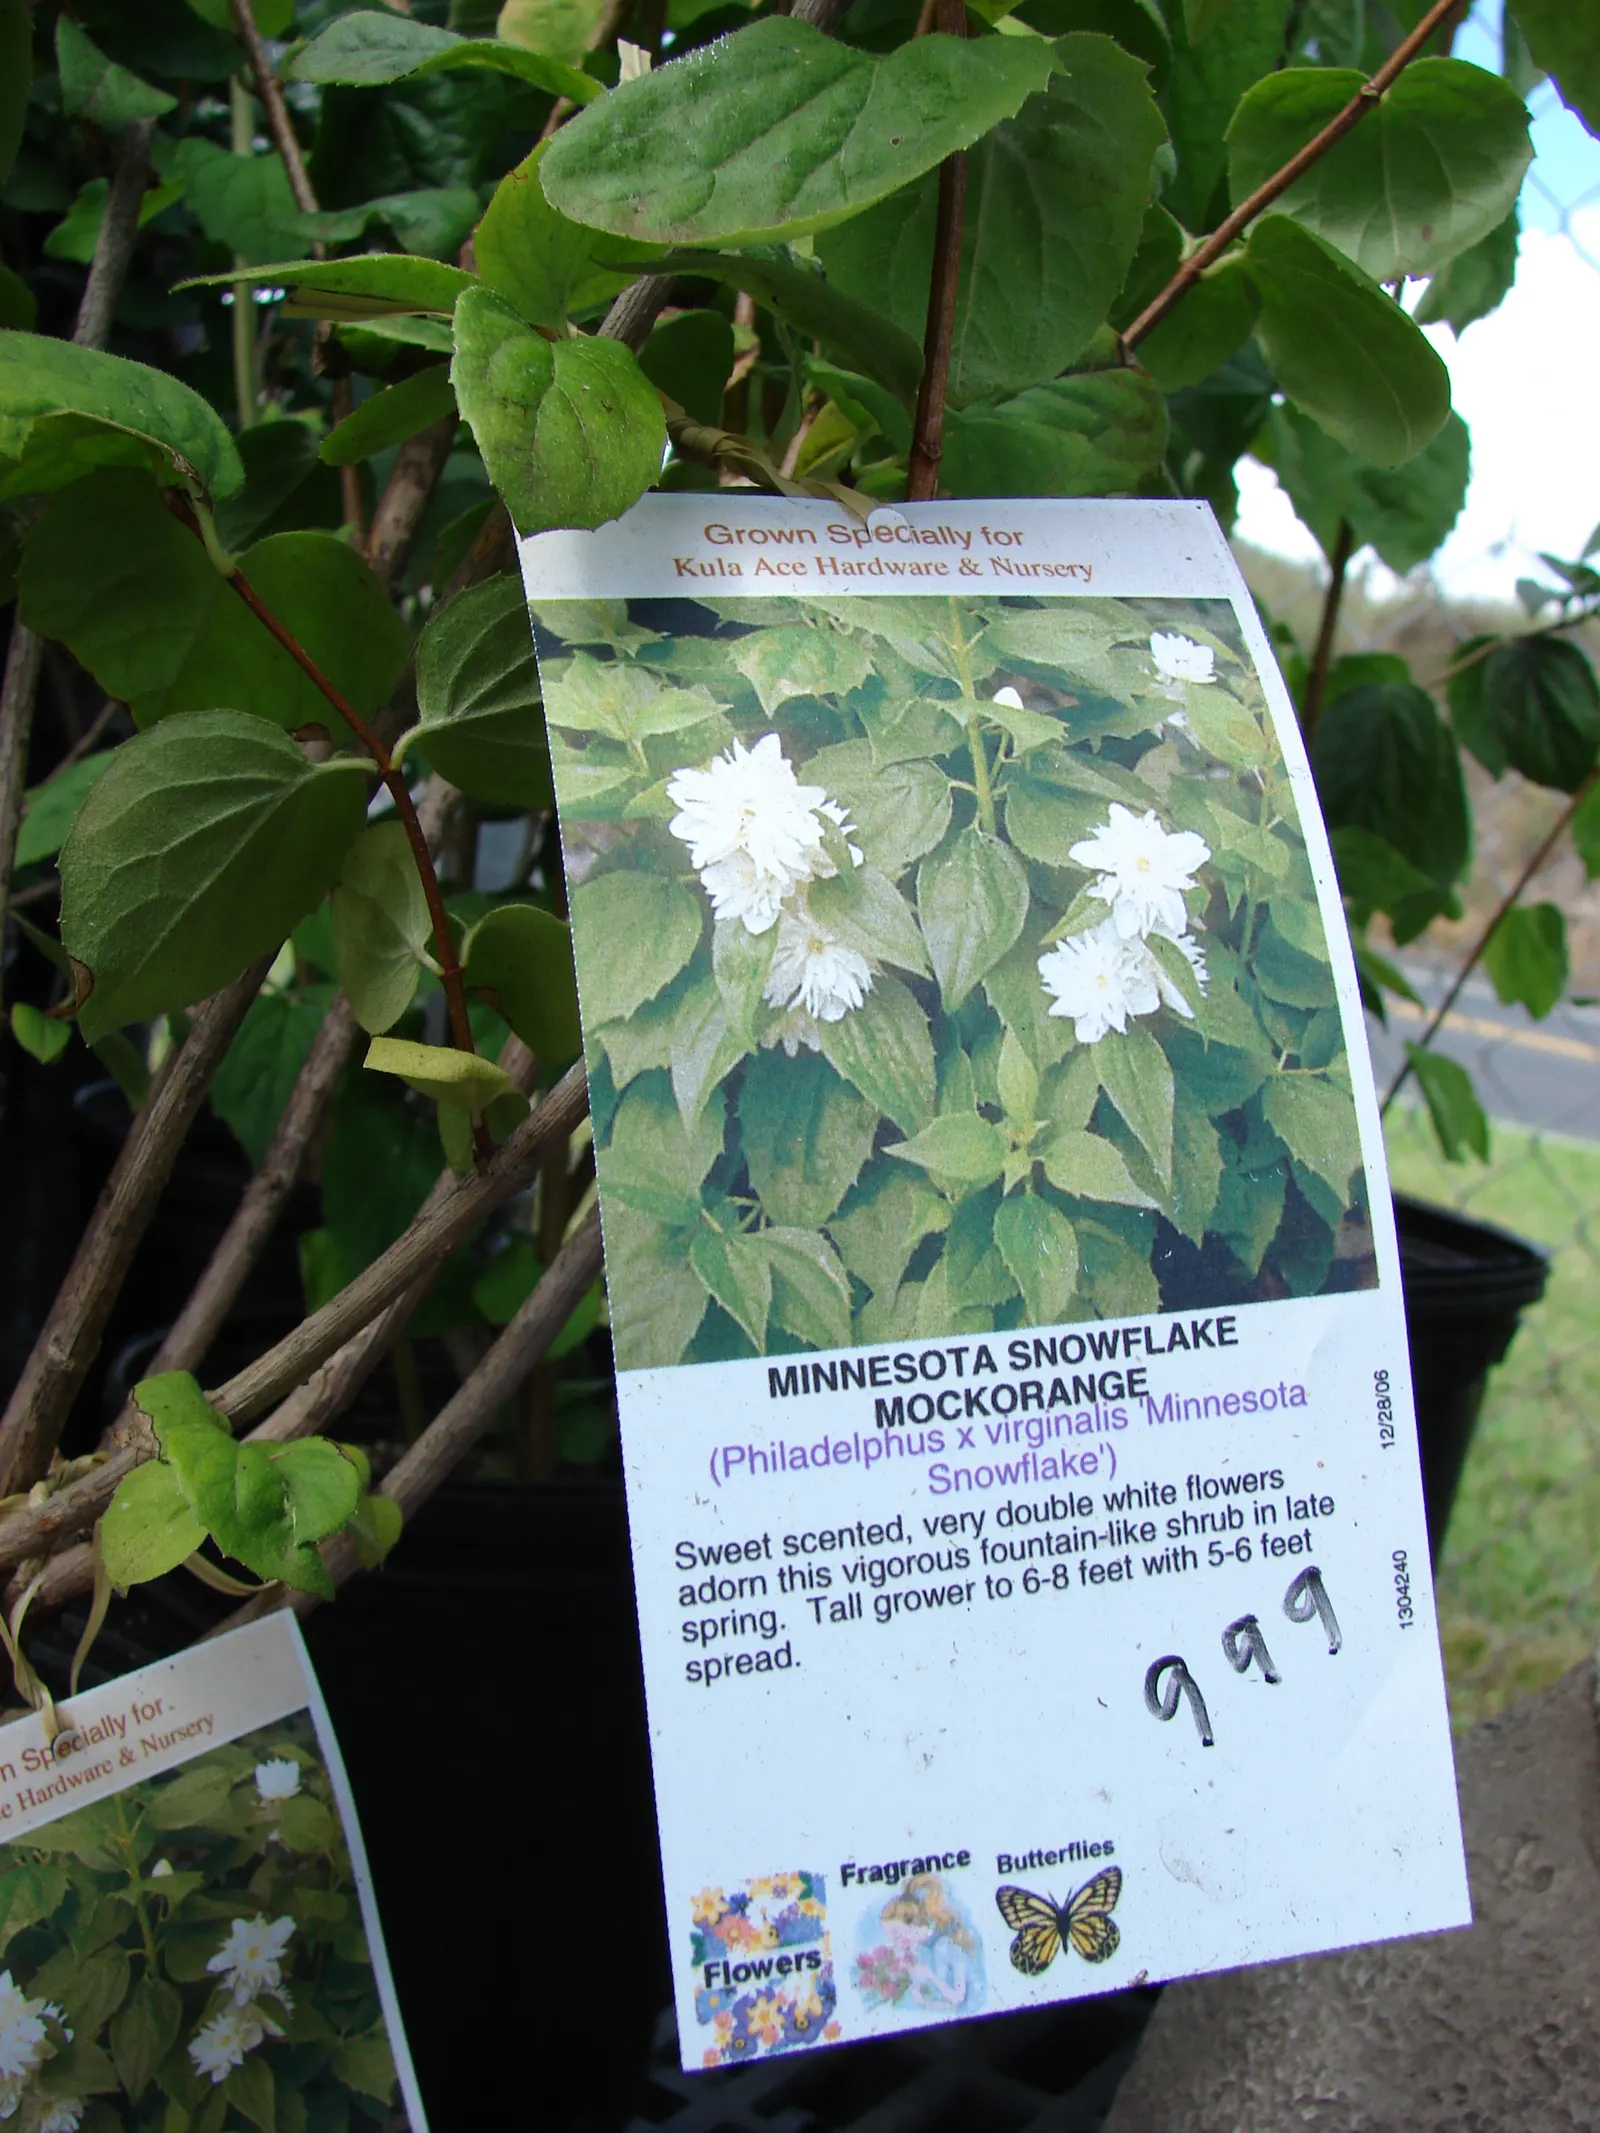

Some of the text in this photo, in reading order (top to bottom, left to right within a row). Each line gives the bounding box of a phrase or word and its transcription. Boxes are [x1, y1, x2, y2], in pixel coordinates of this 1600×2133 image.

[674, 556, 1093, 582] Kula Ace Hardware & Nursery
[704, 524, 1024, 549] Grown Specially for
[768, 1315, 1239, 1398] MINNESOTA SNOWFLAKE
[709, 1380, 1308, 1487] (Philadelphus x virginalis 'Minnesota
[874, 1368, 1150, 1429] MOCKORANGE
[1374, 1369, 1395, 1450] 12/28/06
[928, 1444, 1118, 1496] Snowflake')
[675, 1468, 1285, 1570] Sweet scented, very double white flowers
[679, 1493, 1335, 1609] adorn this vigorous fountain-like shrub in late
[681, 1529, 1312, 1649] spring. Tall grower to 6-8 feet with 5-6 feet
[1392, 1550, 1414, 1630] 1304240
[685, 1643, 800, 1686] spread.
[17, 1760, 113, 1811] Hardware
[119, 1747, 136, 1767] &
[142, 1713, 214, 1757] Nursery
[22, 1697, 163, 1772] Specially for
[841, 1849, 972, 1887] Fragrance
[997, 1838, 1115, 1875] Butterflies
[704, 1949, 822, 1989] Flowers
